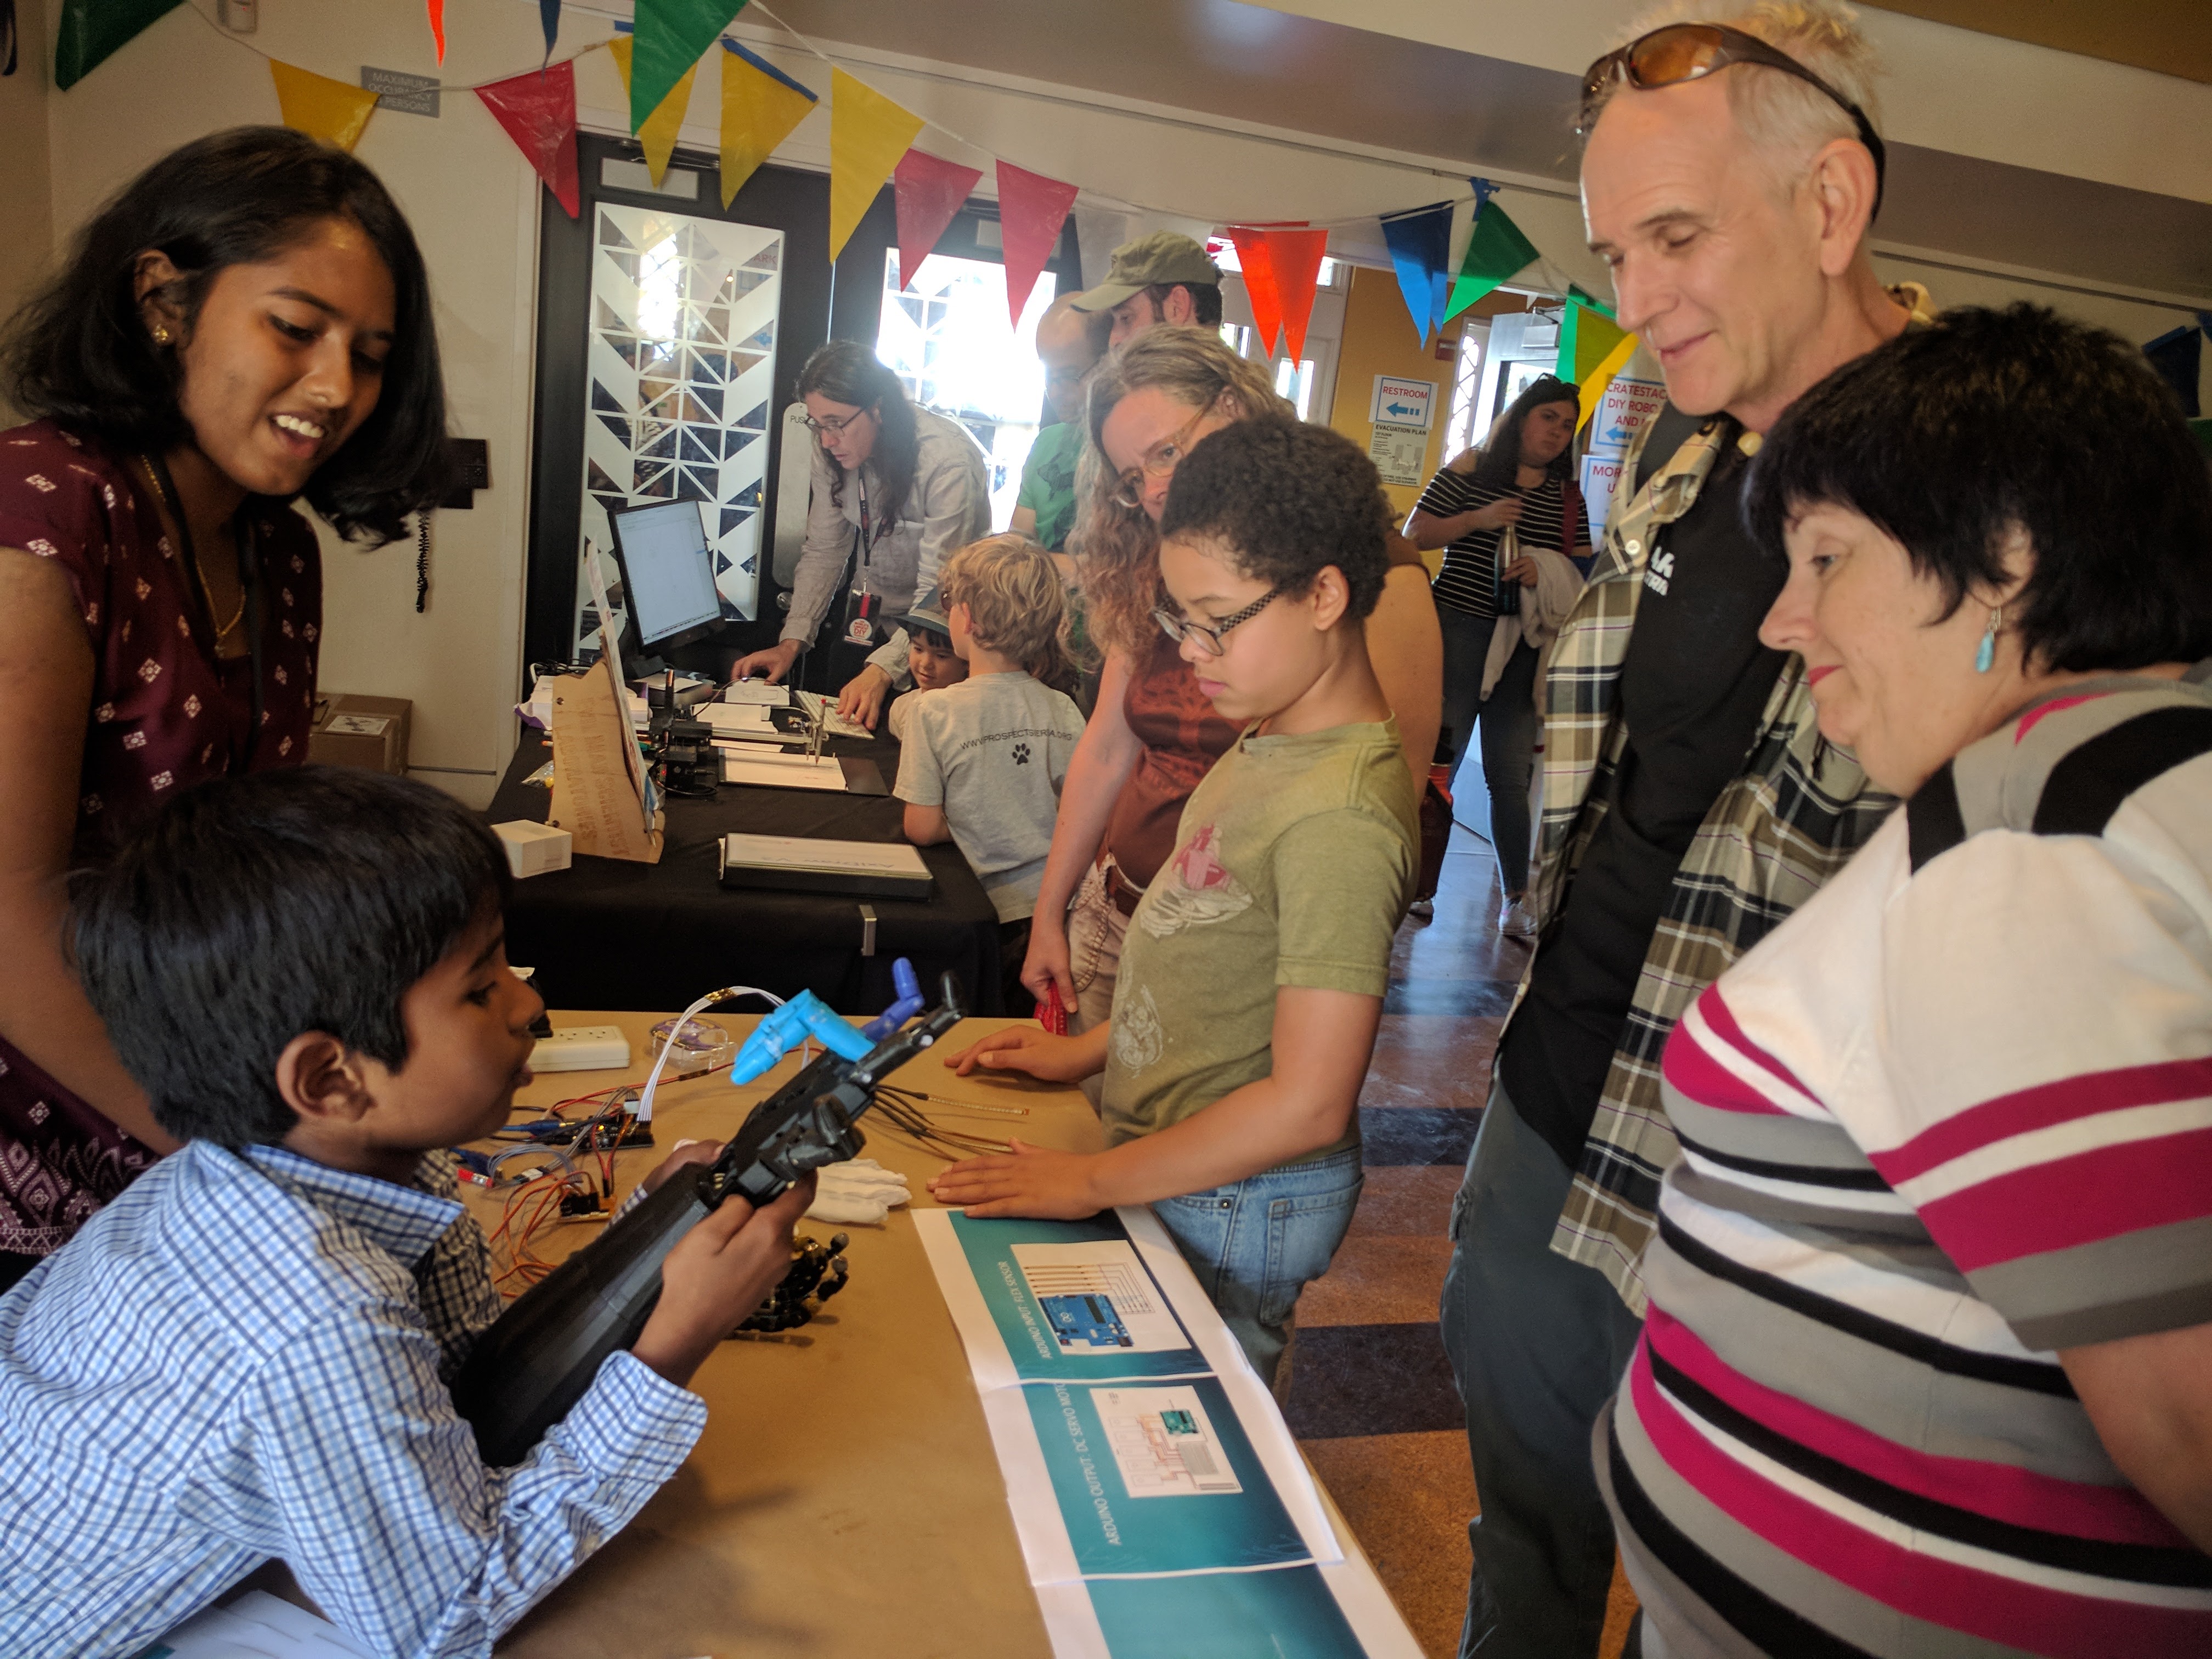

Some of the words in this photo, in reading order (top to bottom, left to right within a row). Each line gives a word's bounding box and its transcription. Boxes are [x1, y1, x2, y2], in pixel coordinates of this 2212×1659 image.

[1383, 386, 1428, 399] RESTROOM
[1607, 382, 1668, 399] CRATESTAC
[1608, 398, 1626, 409] DIY
[1628, 400, 1658, 414] ROBO
[1615, 415, 1639, 426] AND
[1375, 425, 1411, 433] EVACUATION
[1593, 466, 1622, 478] MOR
[997, 1261, 1016, 1286] SENSOR
[1027, 1326, 1053, 1360] ARDUINO
[1063, 1407, 1083, 1436] SERVO
[1073, 1438, 1088, 1452] DC
[1094, 1498, 1122, 1546] ARDUINO
